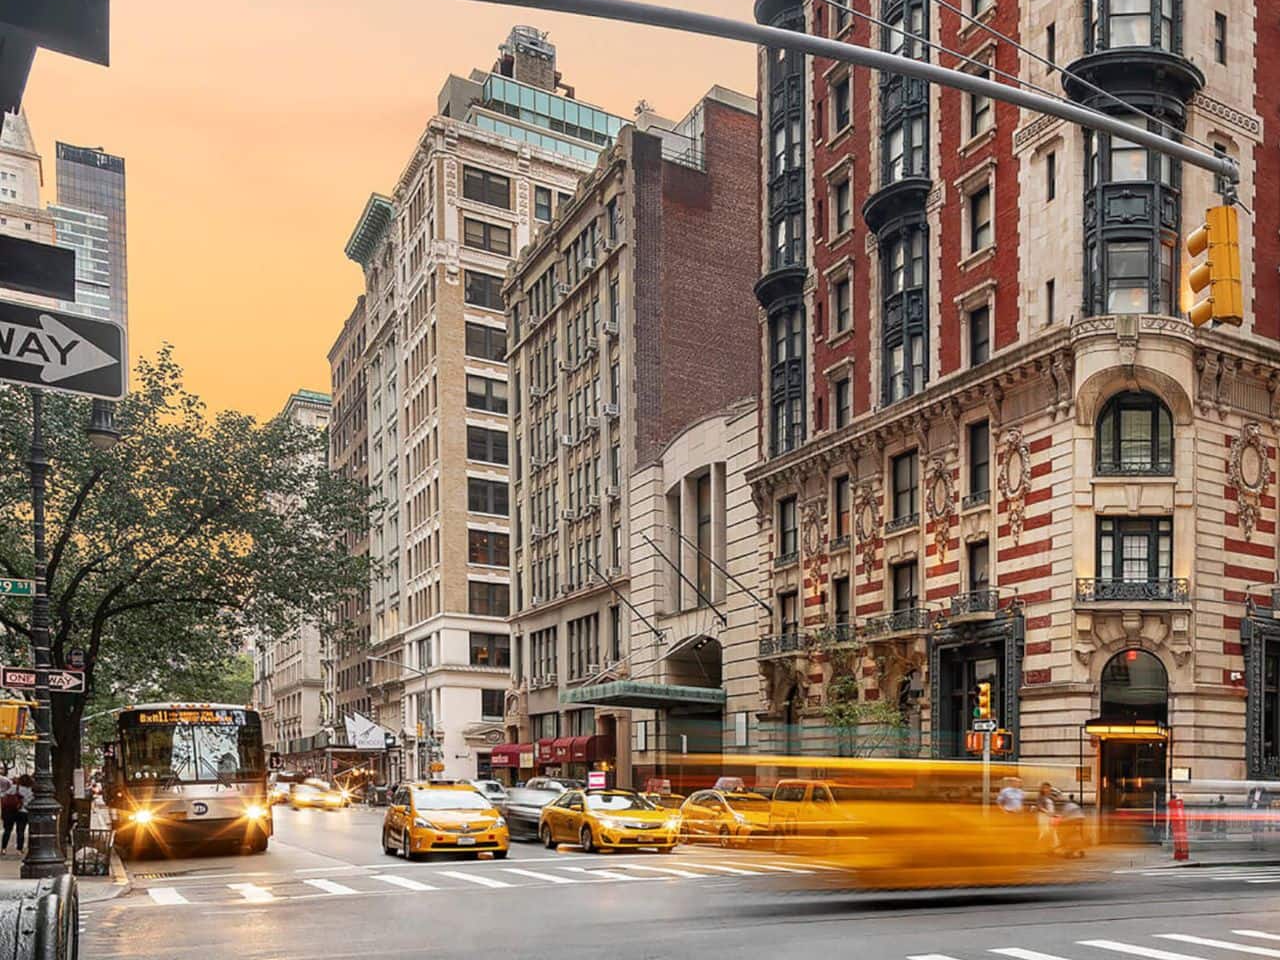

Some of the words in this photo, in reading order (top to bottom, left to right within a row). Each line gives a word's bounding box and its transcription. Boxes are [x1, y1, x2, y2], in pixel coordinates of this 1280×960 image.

[0, 581, 12, 593] 9
[9, 673, 34, 683] ONE
[48, 676, 72, 685] WAY
